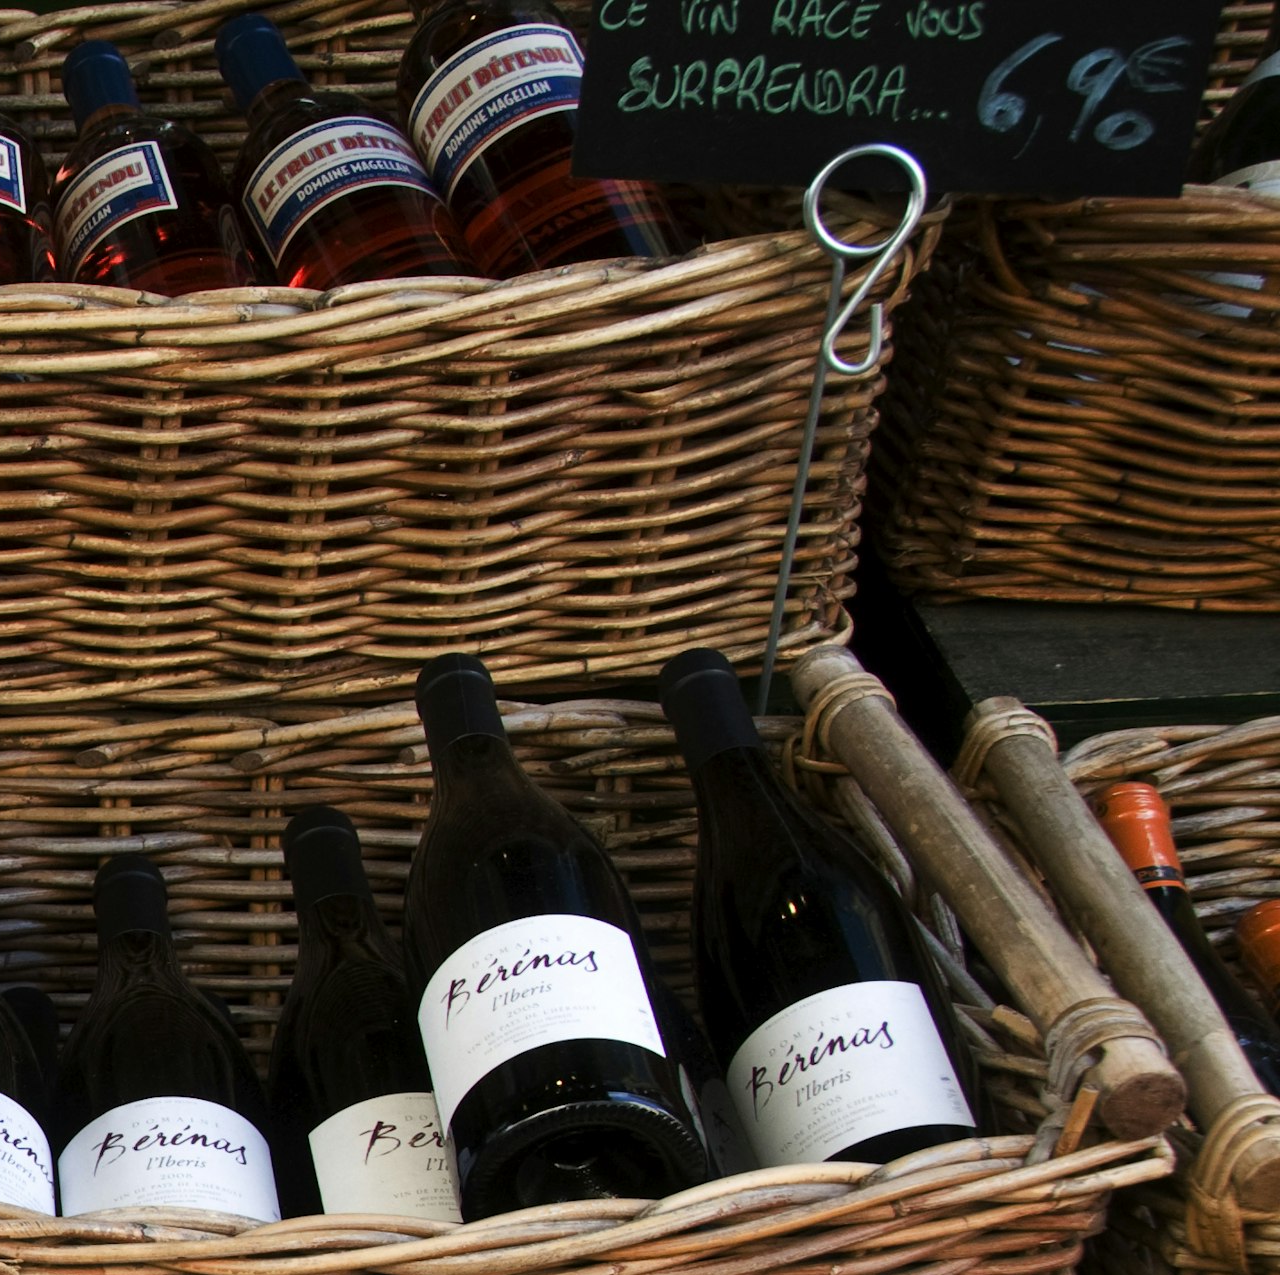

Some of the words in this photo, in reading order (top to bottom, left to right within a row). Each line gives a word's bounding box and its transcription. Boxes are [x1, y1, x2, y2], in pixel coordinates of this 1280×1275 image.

[472, 46, 574, 89] DÉFENDU
[444, 108, 488, 159] DOMAINE
[489, 80, 553, 118] MAGELLAN
[258, 182, 281, 214] LE
[273, 138, 337, 191] FRUIT
[296, 164, 351, 203] DOMAINE
[351, 159, 412, 175] MAGELLAN
[440, 948, 600, 1032] Bérénas
[744, 1020, 896, 1123] Bérénas
[91, 1124, 248, 1177] Bérénas
